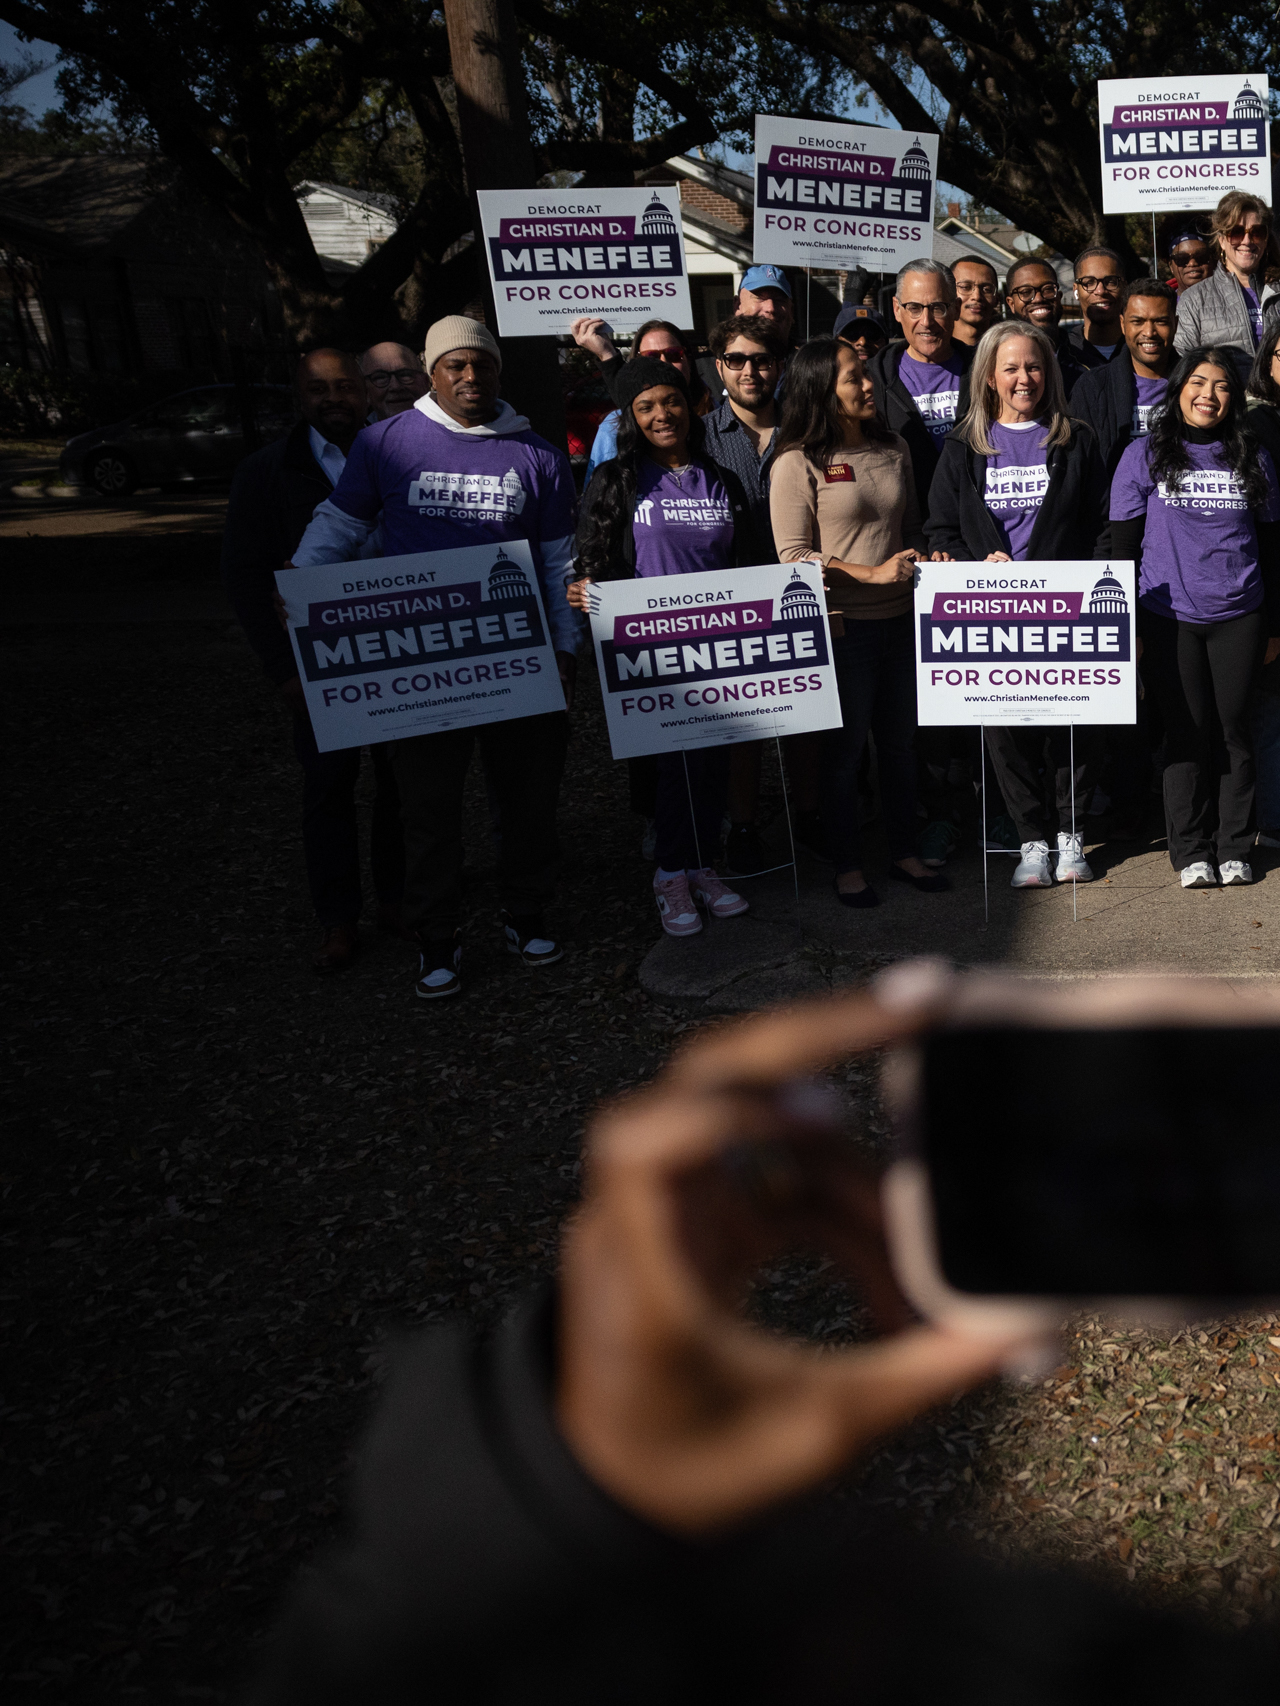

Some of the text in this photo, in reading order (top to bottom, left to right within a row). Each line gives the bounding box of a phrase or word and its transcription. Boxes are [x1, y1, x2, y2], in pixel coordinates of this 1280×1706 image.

[1138, 92, 1200, 102] DEMOCRAT
[1121, 108, 1219, 123] CHRISTIAN D.
[799, 136, 866, 151] DEMOCRAT
[1112, 128, 1257, 154] MENEFEE
[778, 153, 885, 175] CHRISTIAN D.
[1113, 163, 1259, 181] FOR CONGRESS
[767, 176, 922, 213] MENEFEE
[1138, 185, 1235, 193] www.ChristianMenefee.com
[528, 205, 601, 214] DEMOCRAT
[509, 223, 626, 237] CHRISTIAN D.
[765, 214, 921, 241] FOR CONGRESS
[792, 241, 895, 253] www.ChristianMenefee.com
[501, 246, 673, 272] MENEFEE
[506, 282, 676, 301] FOR CONGRESS
[538, 306, 651, 315] www.ChristianMenefee.com
[425, 475, 493, 486] CHRISTIAN D.
[990, 469, 1036, 478] CHRISTIAN
[986, 480, 1046, 494] MENEF
[418, 488, 517, 508] MENEFEE
[660, 498, 729, 508] CHRISTIAN
[1010, 497, 1043, 508] CONG
[1165, 499, 1248, 510] FOR CONGRESS
[419, 507, 516, 522] FOR CONGRESS
[663, 509, 734, 522] MENEFE
[343, 572, 436, 594] DEMOCRAT
[967, 579, 1047, 588] DEMOCRAT
[321, 591, 470, 624] CHRISTIAN D.
[647, 590, 733, 608] DEMOCRAT
[943, 600, 1071, 614] CHRISTIAN D.
[625, 609, 763, 637] CHRISTIAN D.
[313, 610, 532, 670] MENEFEE
[932, 626, 1119, 653] MENEFEE
[616, 630, 817, 681] MENEFEE
[323, 655, 540, 706] FOR CONGRESS
[931, 669, 1121, 686] FOR CONGRESS
[368, 688, 511, 717] www.ChristianMenefee.com
[621, 674, 822, 716] FOR CONGRESS
[964, 694, 1089, 702] www.ChristianMenefee.com
[660, 705, 793, 728] www.ChristianMenefee.com
